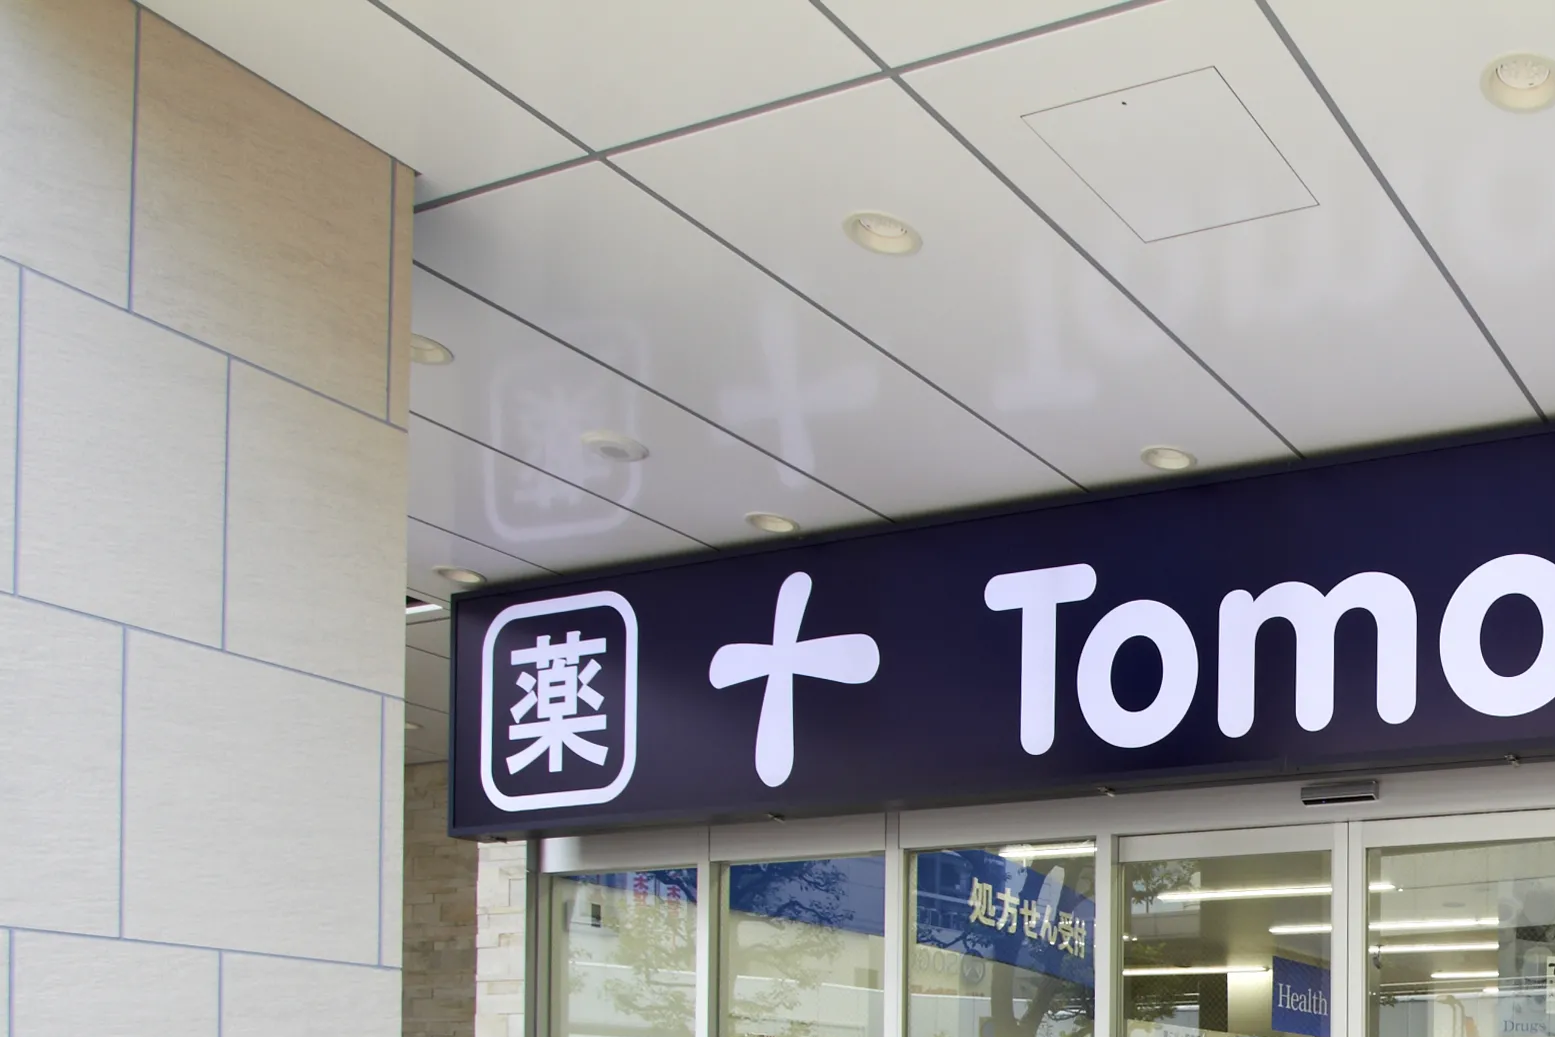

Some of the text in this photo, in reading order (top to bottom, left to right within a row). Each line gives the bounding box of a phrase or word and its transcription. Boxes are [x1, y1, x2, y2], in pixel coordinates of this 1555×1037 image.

[505, 630, 608, 775] 薬
[968, 877, 1087, 959] 処方せん受付
[1278, 983, 1329, 1016] Health
[1503, 1020, 1547, 1034] Drugs
